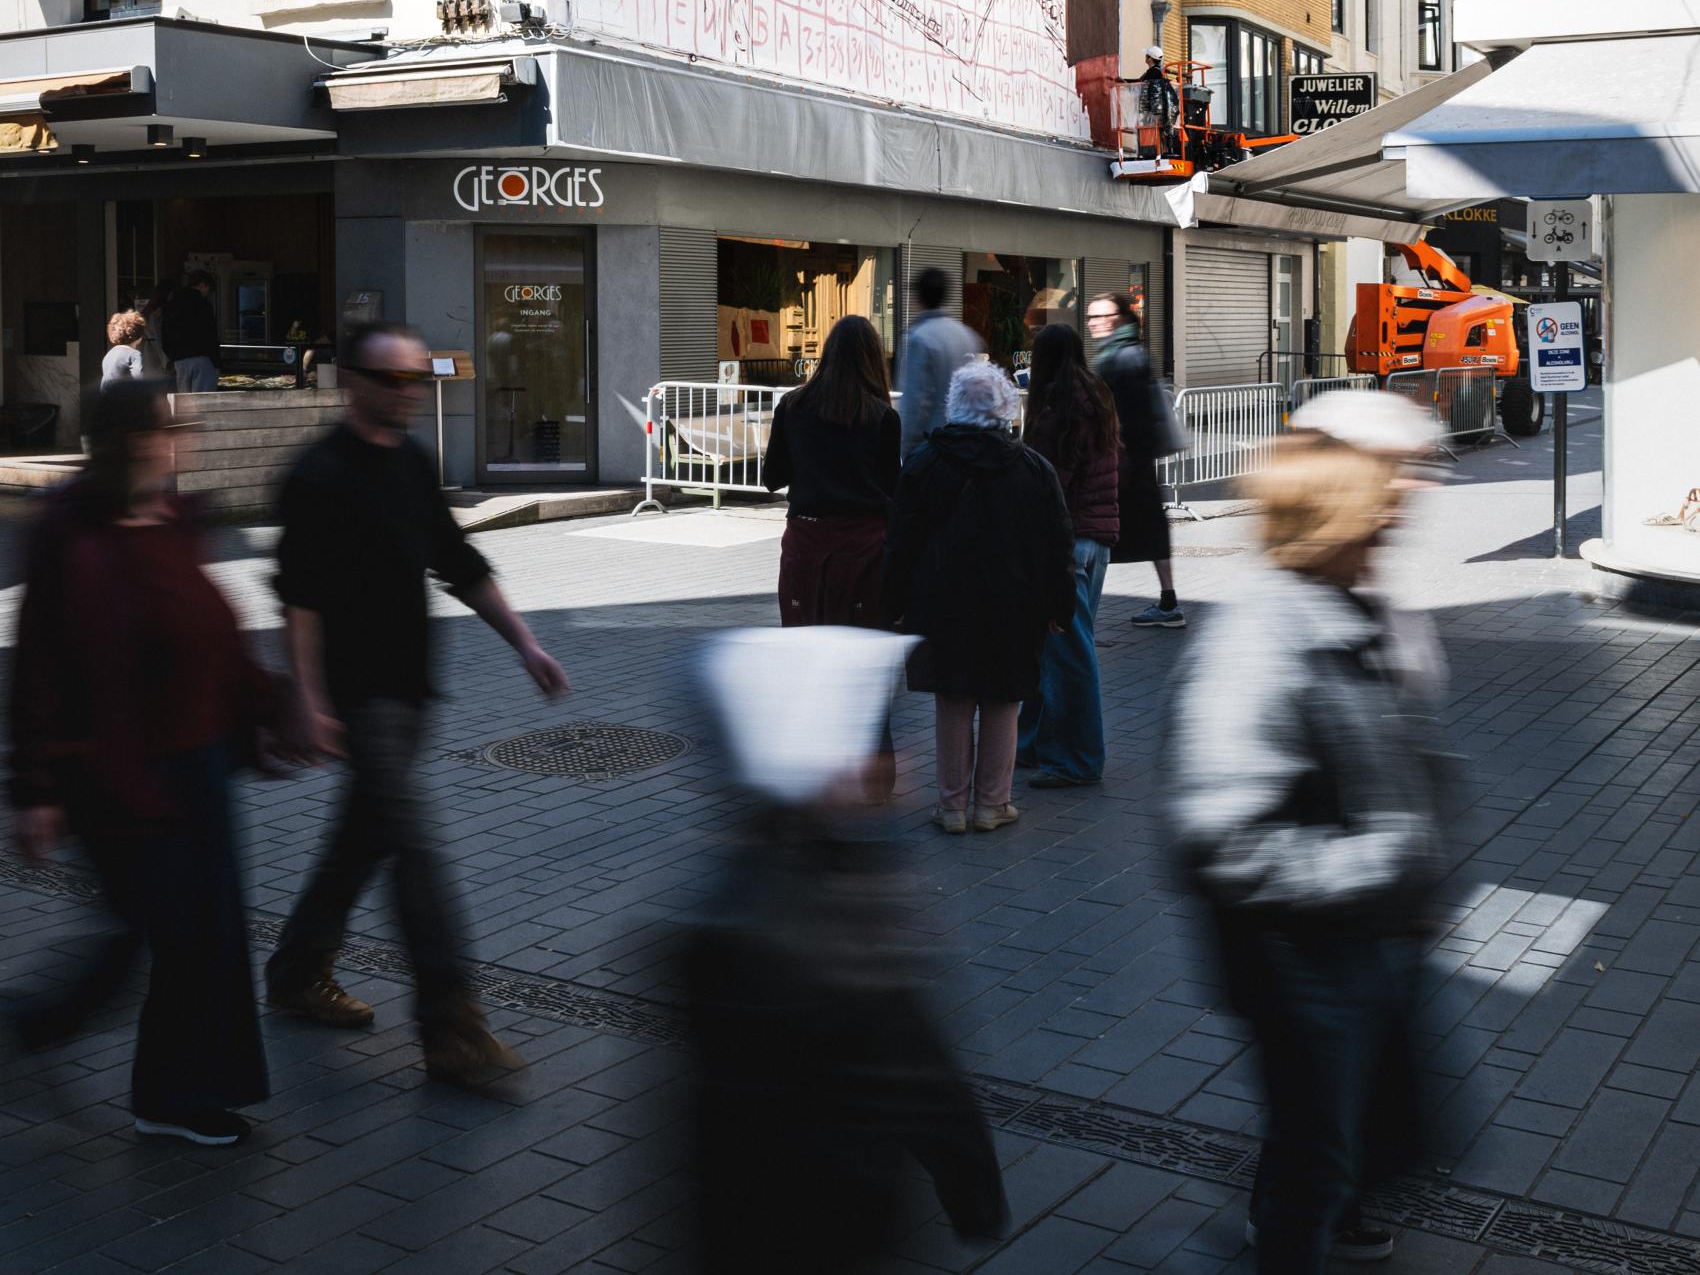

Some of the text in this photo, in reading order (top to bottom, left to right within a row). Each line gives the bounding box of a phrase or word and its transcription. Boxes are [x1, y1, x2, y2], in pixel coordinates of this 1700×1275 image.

[751, 5, 769, 47] B
[780, 12, 792, 51] A
[803, 25, 825, 70] 37
[1300, 78, 1364, 92] JUWELIER
[1315, 99, 1369, 114] Willem
[1292, 118, 1349, 133] CLO
[453, 166, 604, 212] GEORGES
[1443, 207, 1497, 222] KLOKKE
[504, 285, 562, 302] GEORGES
[1560, 322, 1579, 330] GEEN
[1402, 355, 1418, 365] Boels
